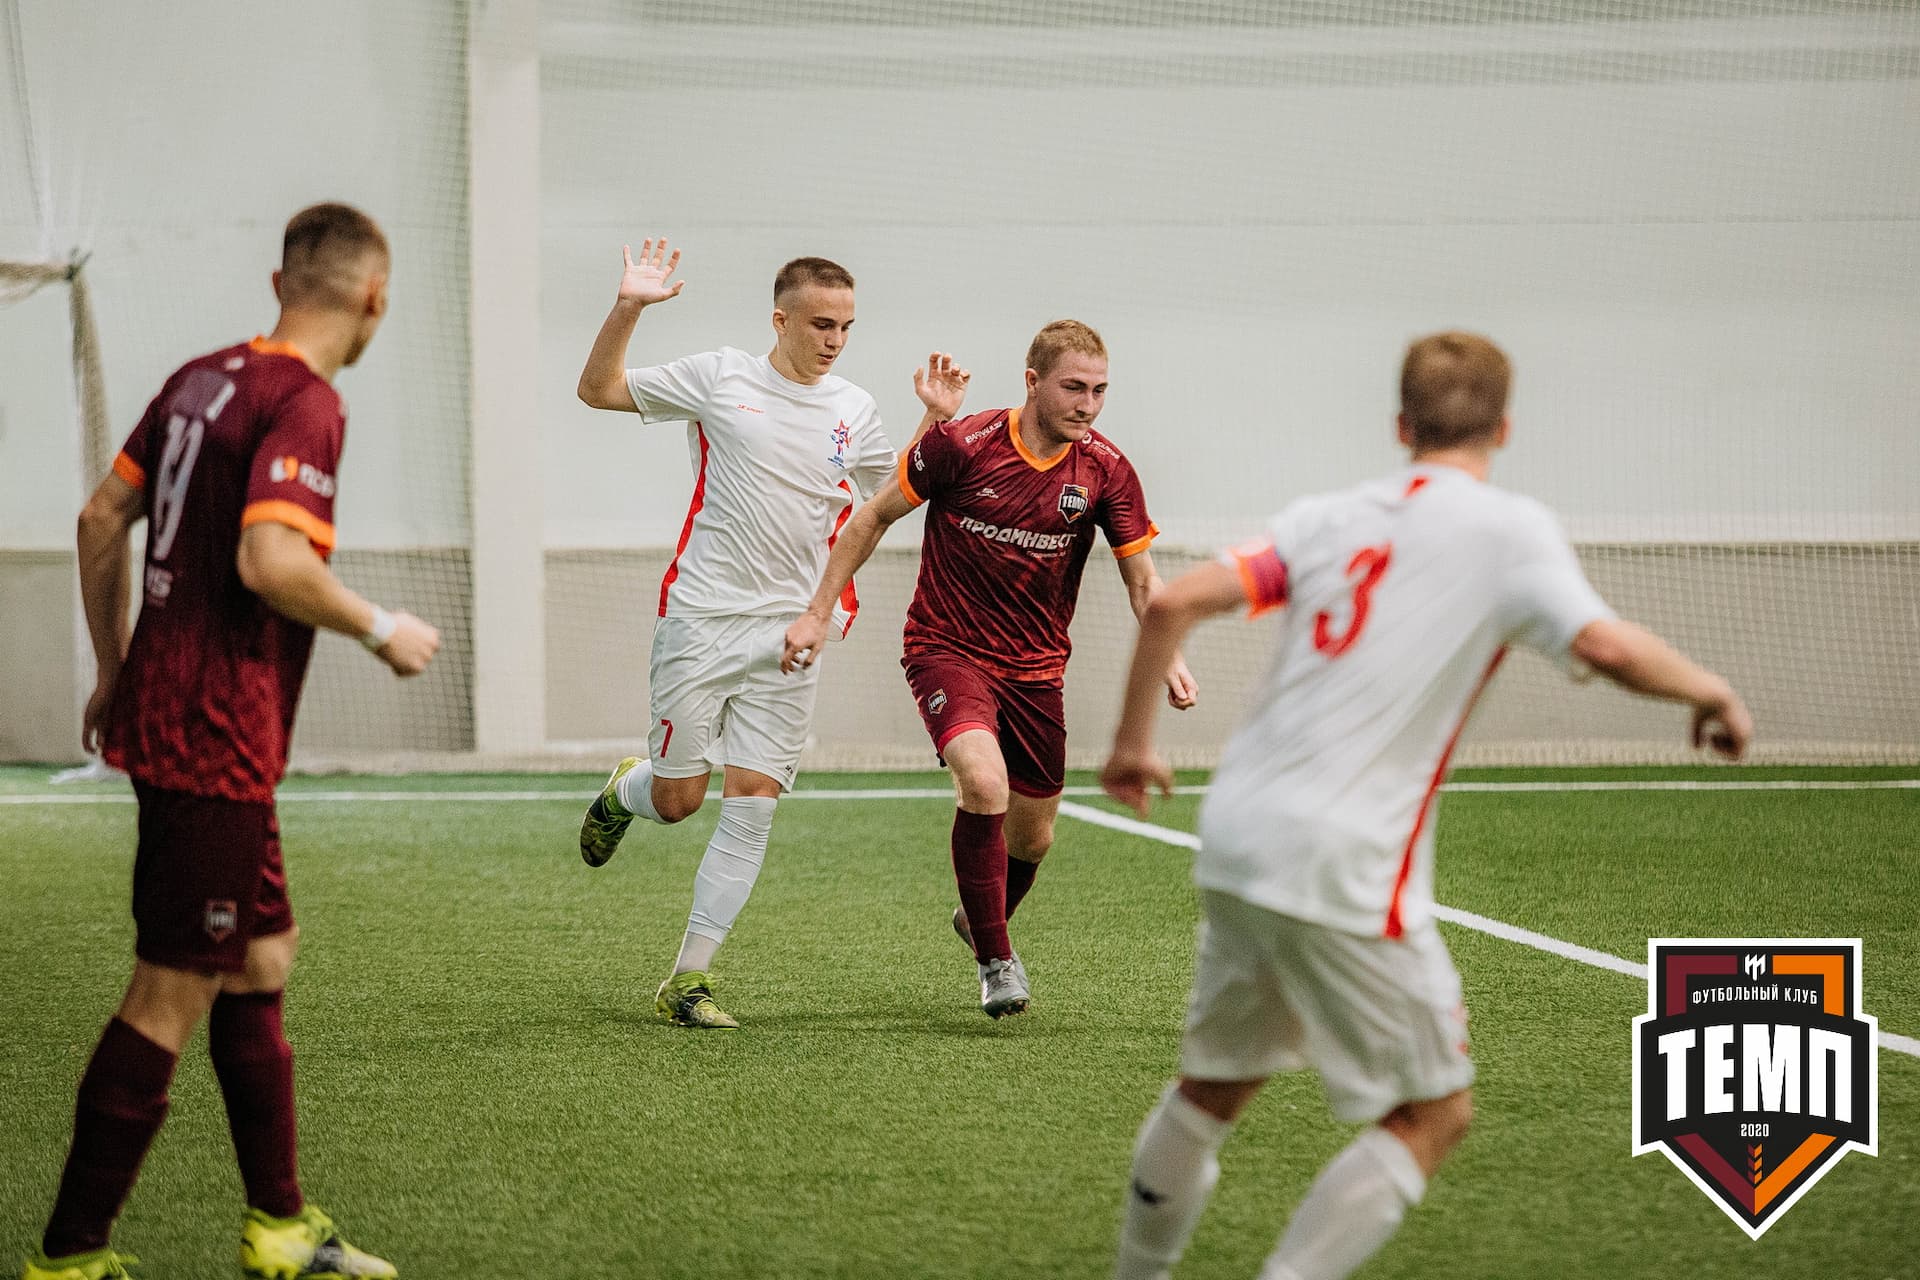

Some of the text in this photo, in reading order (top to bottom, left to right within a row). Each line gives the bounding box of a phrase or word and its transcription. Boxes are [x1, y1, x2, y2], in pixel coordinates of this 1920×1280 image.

[959, 516, 1078, 551] ПРОДИНВЕСТ
[1311, 541, 1393, 661] 3
[660, 718, 674, 759] 7
